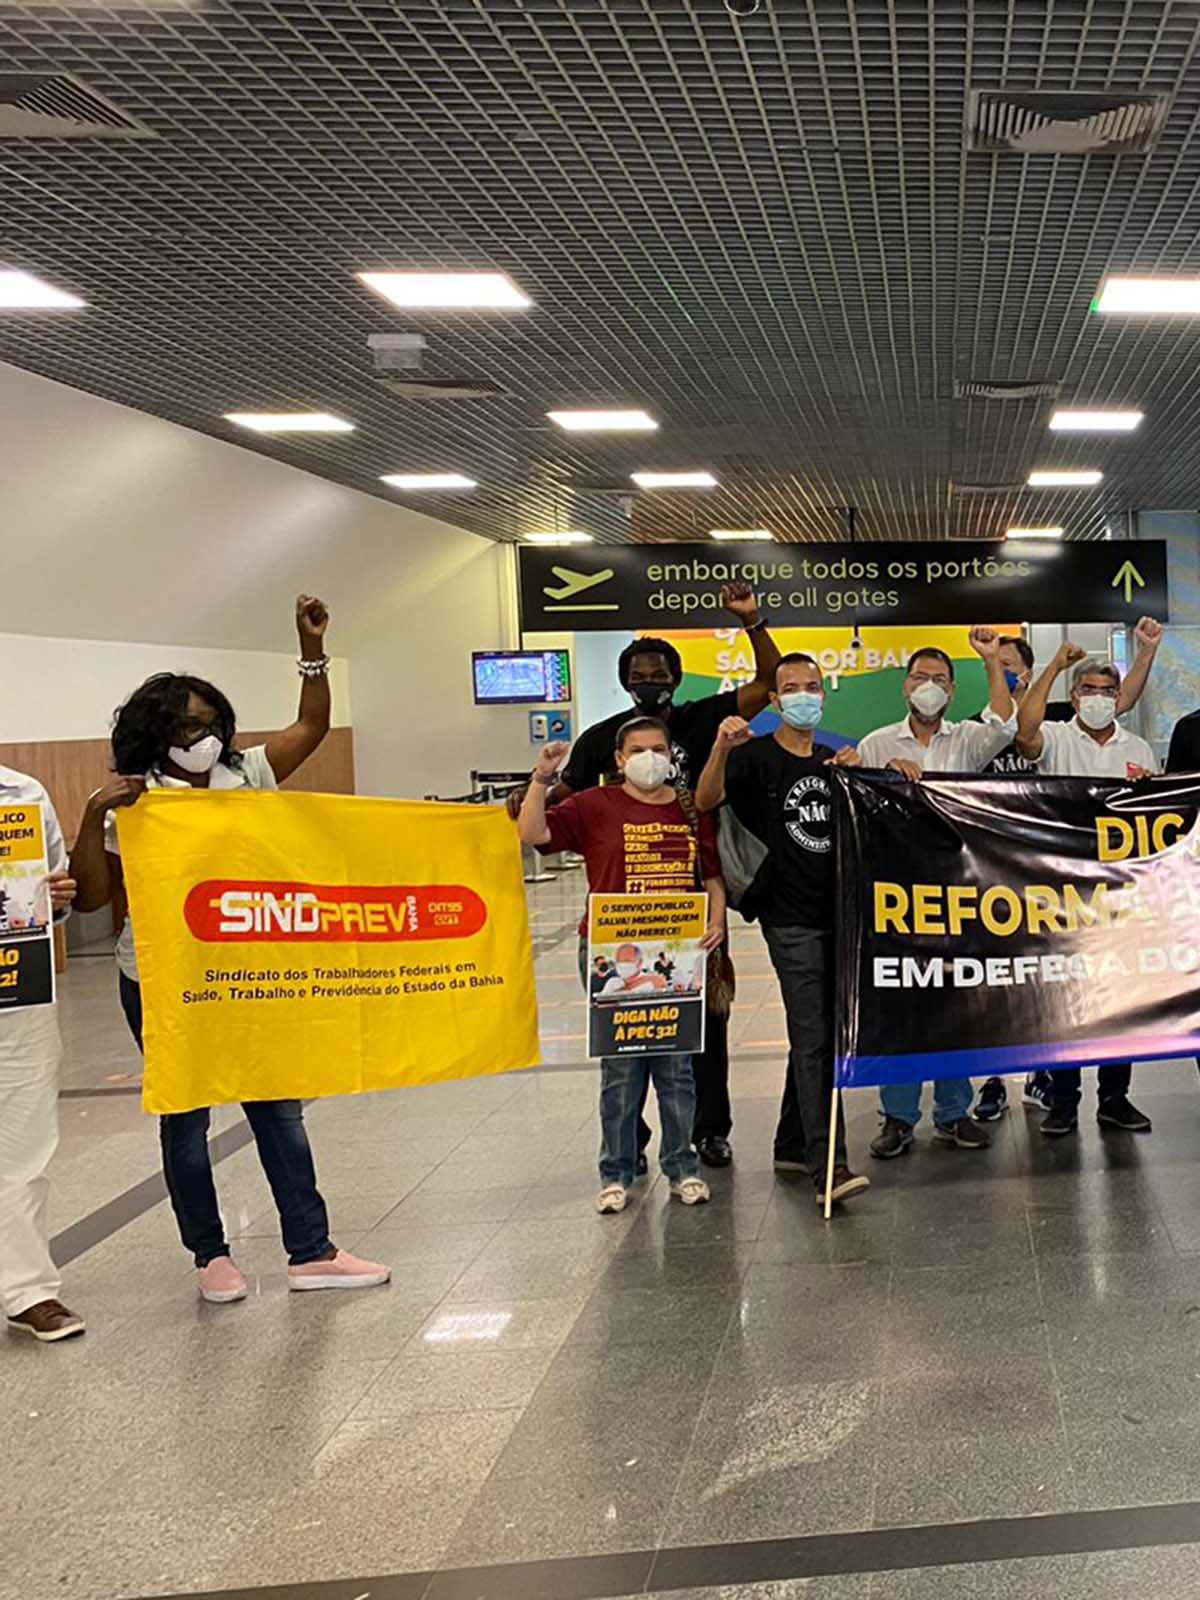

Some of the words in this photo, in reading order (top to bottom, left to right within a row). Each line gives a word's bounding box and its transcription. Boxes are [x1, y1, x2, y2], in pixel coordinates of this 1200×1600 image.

[647, 559, 793, 583] embarque
[802, 557, 878, 579] todos
[888, 562, 917, 578] os
[926, 556, 1030, 583] portões
[788, 588, 818, 607] all
[826, 587, 899, 612] gates
[601, 904, 610, 913] O
[611, 902, 652, 913] SERVIÇO
[632, 914, 669, 924] MESMO
[671, 913, 699, 923] QUEM
[616, 927, 638, 938] NÃO
[639, 926, 681, 936] MERECE!
[205, 968, 280, 982] Sindicato
[283, 968, 308, 980] dos
[313, 967, 396, 979] Trabalhadores
[400, 963, 451, 977] Federais
[455, 962, 476, 973] em
[873, 956, 945, 988] EM
[953, 950, 1130, 988] DEFESA
[228, 986, 296, 1000] Trabalho
[298, 990, 306, 998] e
[311, 984, 383, 998] Previdência
[385, 984, 400, 995] do
[403, 980, 446, 994] Estado
[449, 978, 466, 989] da
[469, 974, 504, 988] Bahia
[613, 1010, 647, 1024] DIGA
[650, 1005, 680, 1021] NÃO
[627, 1025, 656, 1040] PEC
[656, 1022, 678, 1039] 32!
